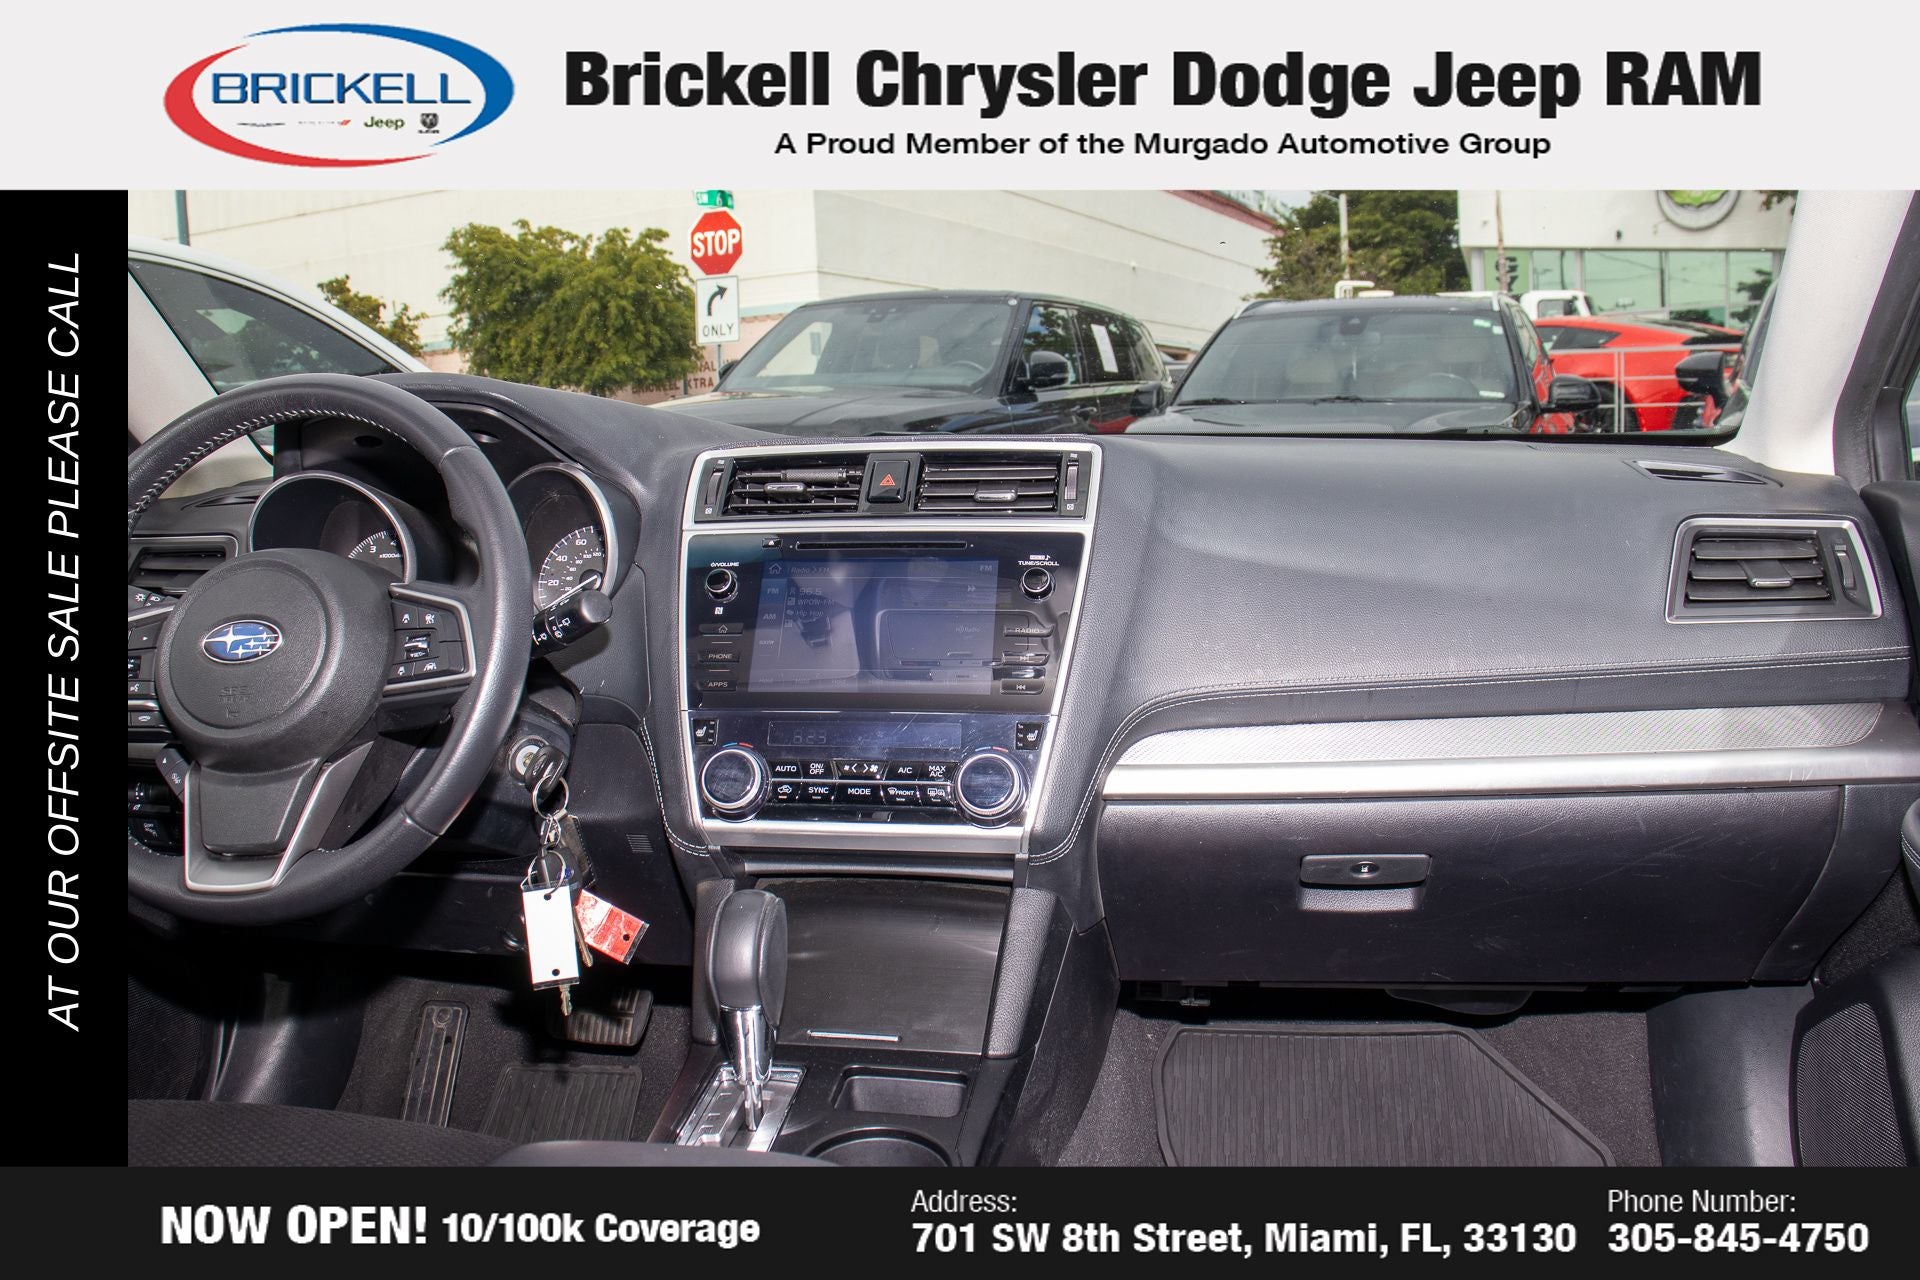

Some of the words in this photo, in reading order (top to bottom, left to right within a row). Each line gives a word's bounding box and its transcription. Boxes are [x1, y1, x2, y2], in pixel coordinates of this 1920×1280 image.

[692, 229, 740, 258] STOP
[702, 323, 734, 337] ONLY
[767, 587, 780, 595] FM
